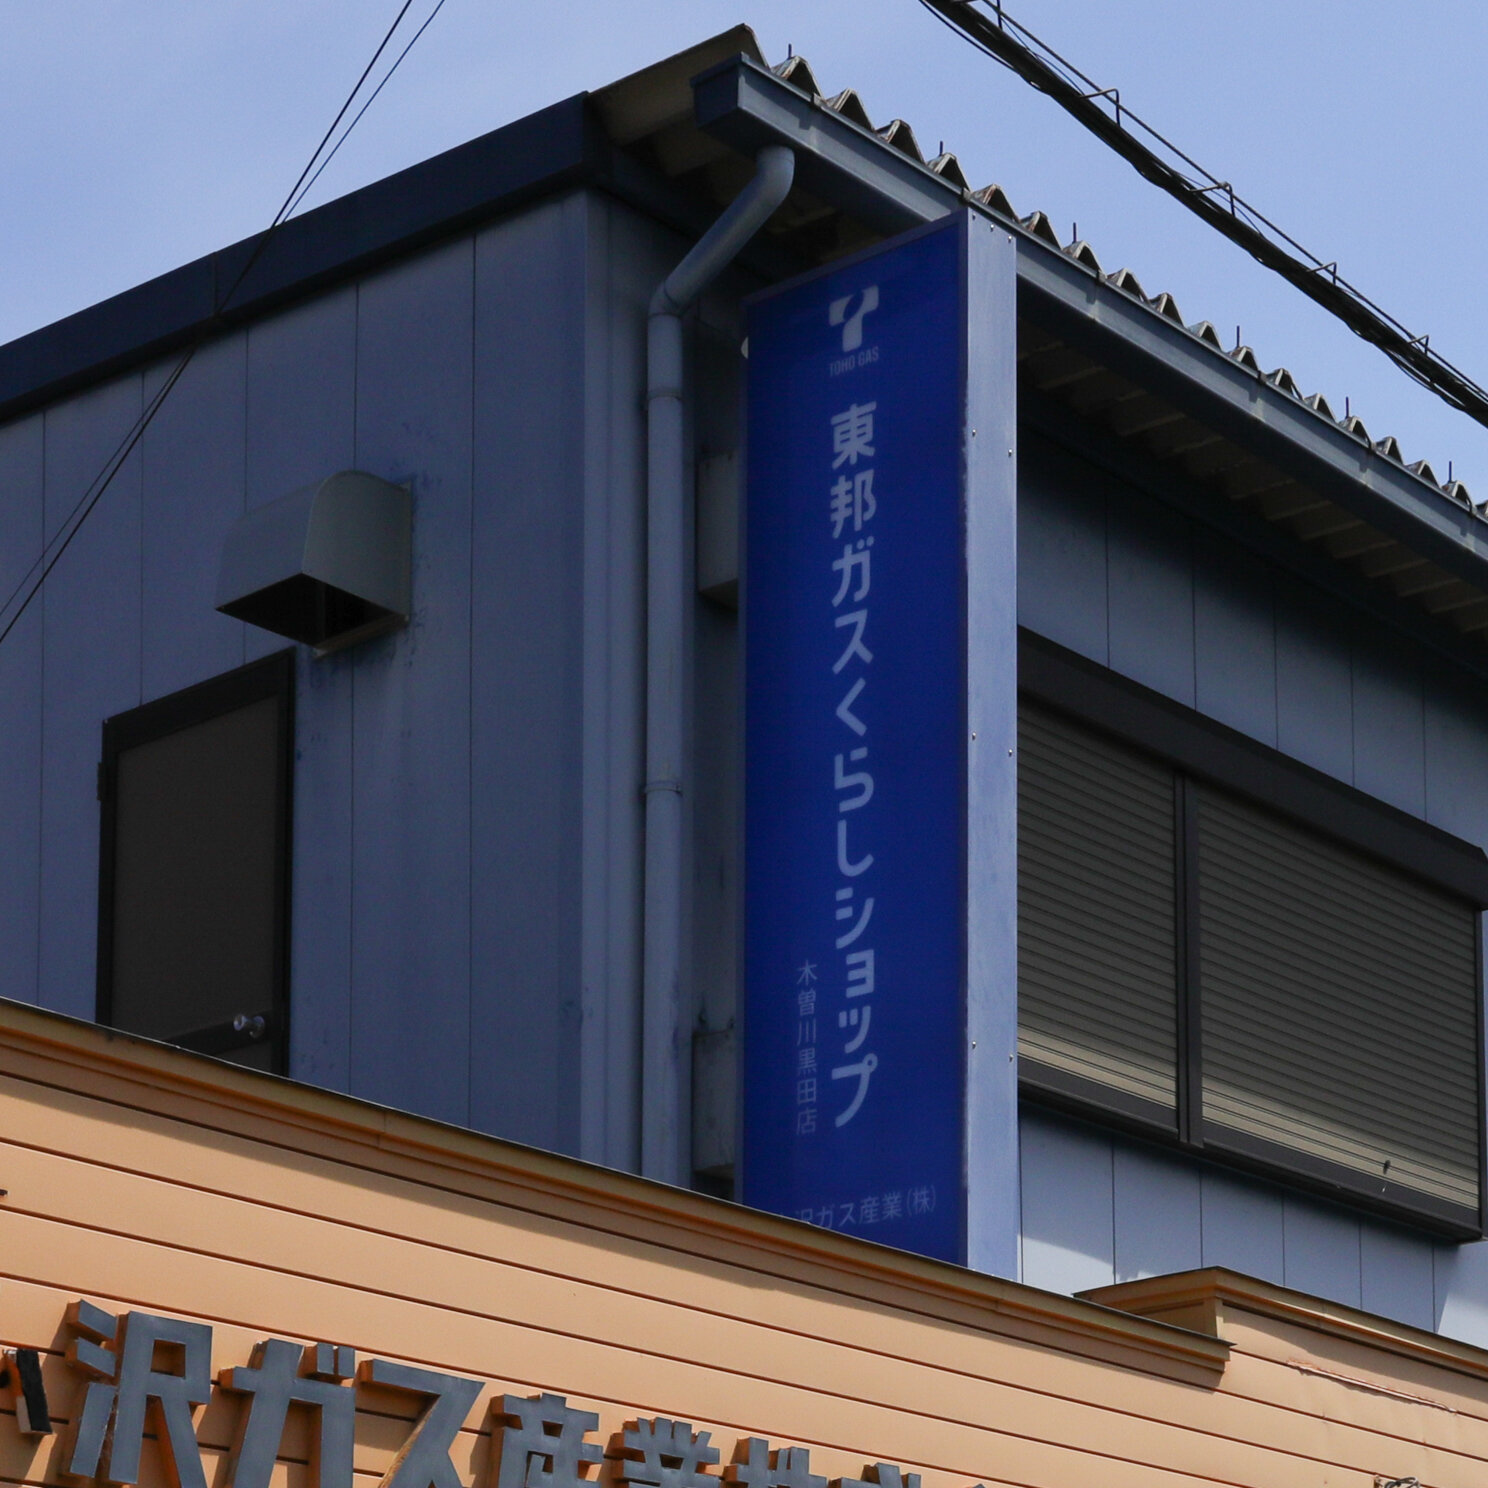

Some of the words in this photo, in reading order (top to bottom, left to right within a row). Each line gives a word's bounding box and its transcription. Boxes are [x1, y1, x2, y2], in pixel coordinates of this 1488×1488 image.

[829, 355, 855, 377] TOHO
[858, 346, 879, 367] GAS
[829, 400, 879, 1130] 東邦ガスくらしショップ
[796, 959, 817, 1136] 木曽川黒田店
